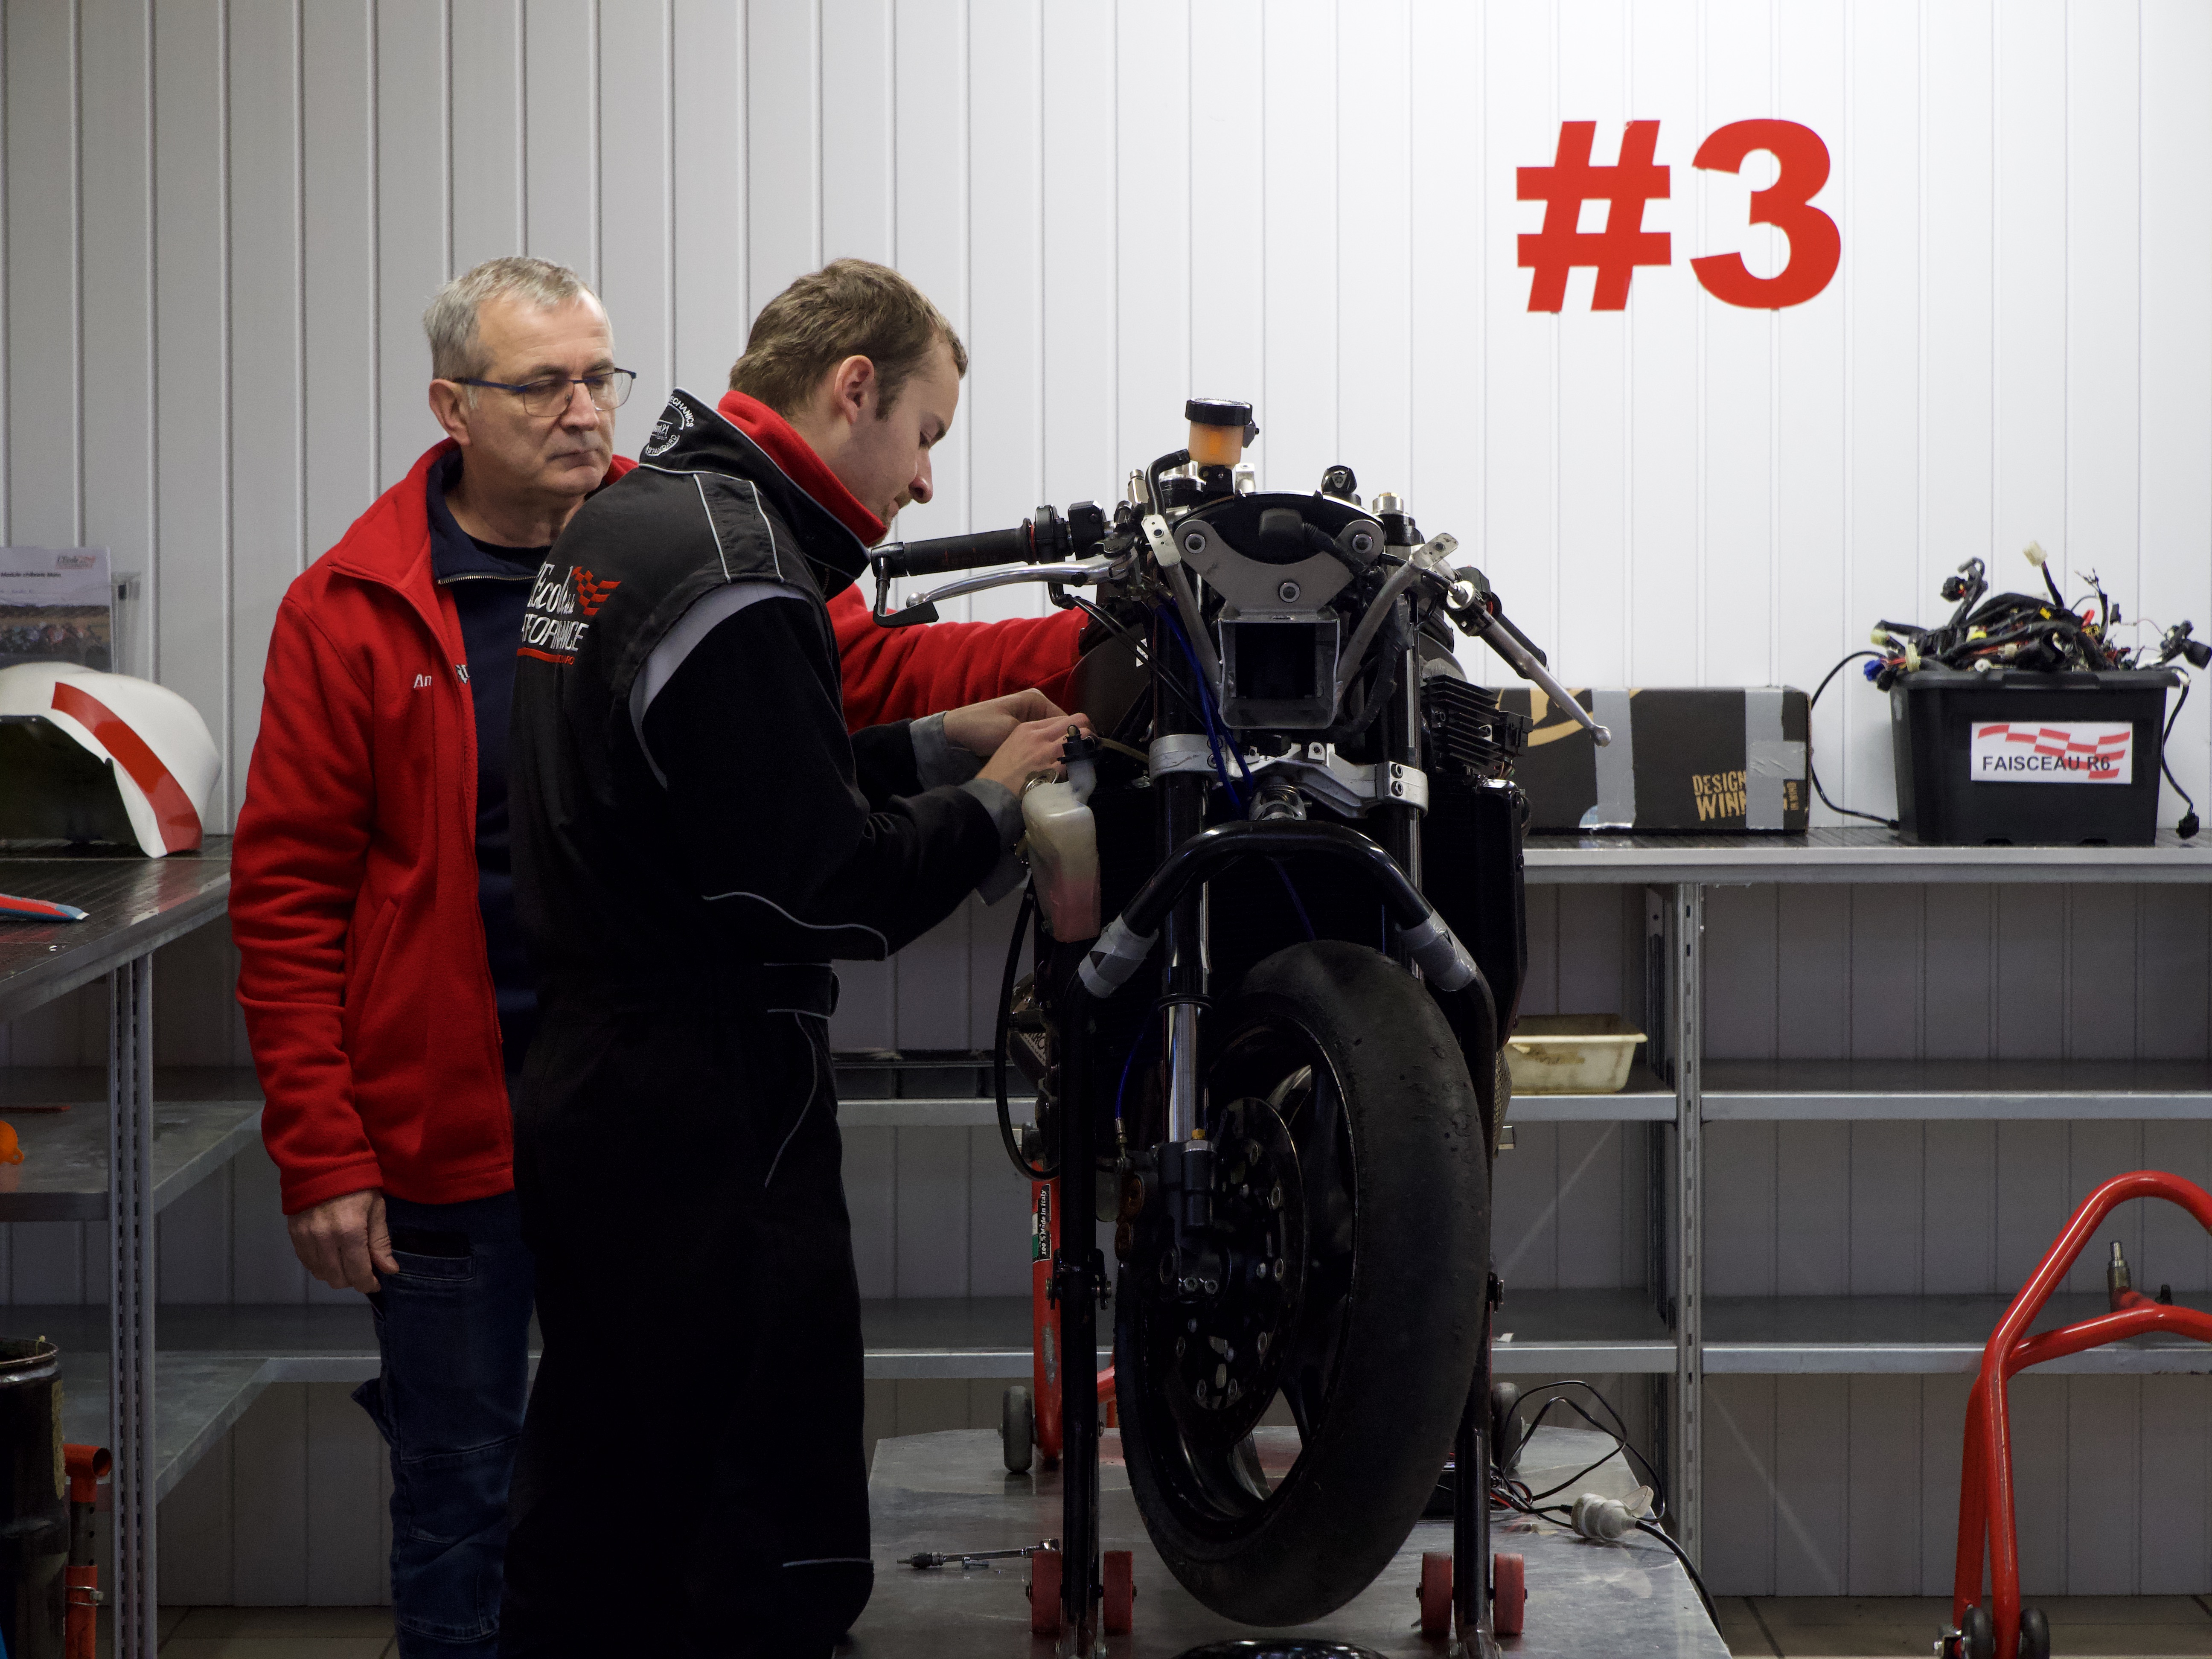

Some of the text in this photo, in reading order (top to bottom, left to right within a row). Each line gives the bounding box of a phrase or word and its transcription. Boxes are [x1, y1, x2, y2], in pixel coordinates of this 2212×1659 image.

[1516, 119, 1841, 312] #3
[669, 396, 694, 428] ECHANICS
[1983, 756, 2110, 771] FAISCEAU R6
[1040, 1207, 1046, 1215] in
